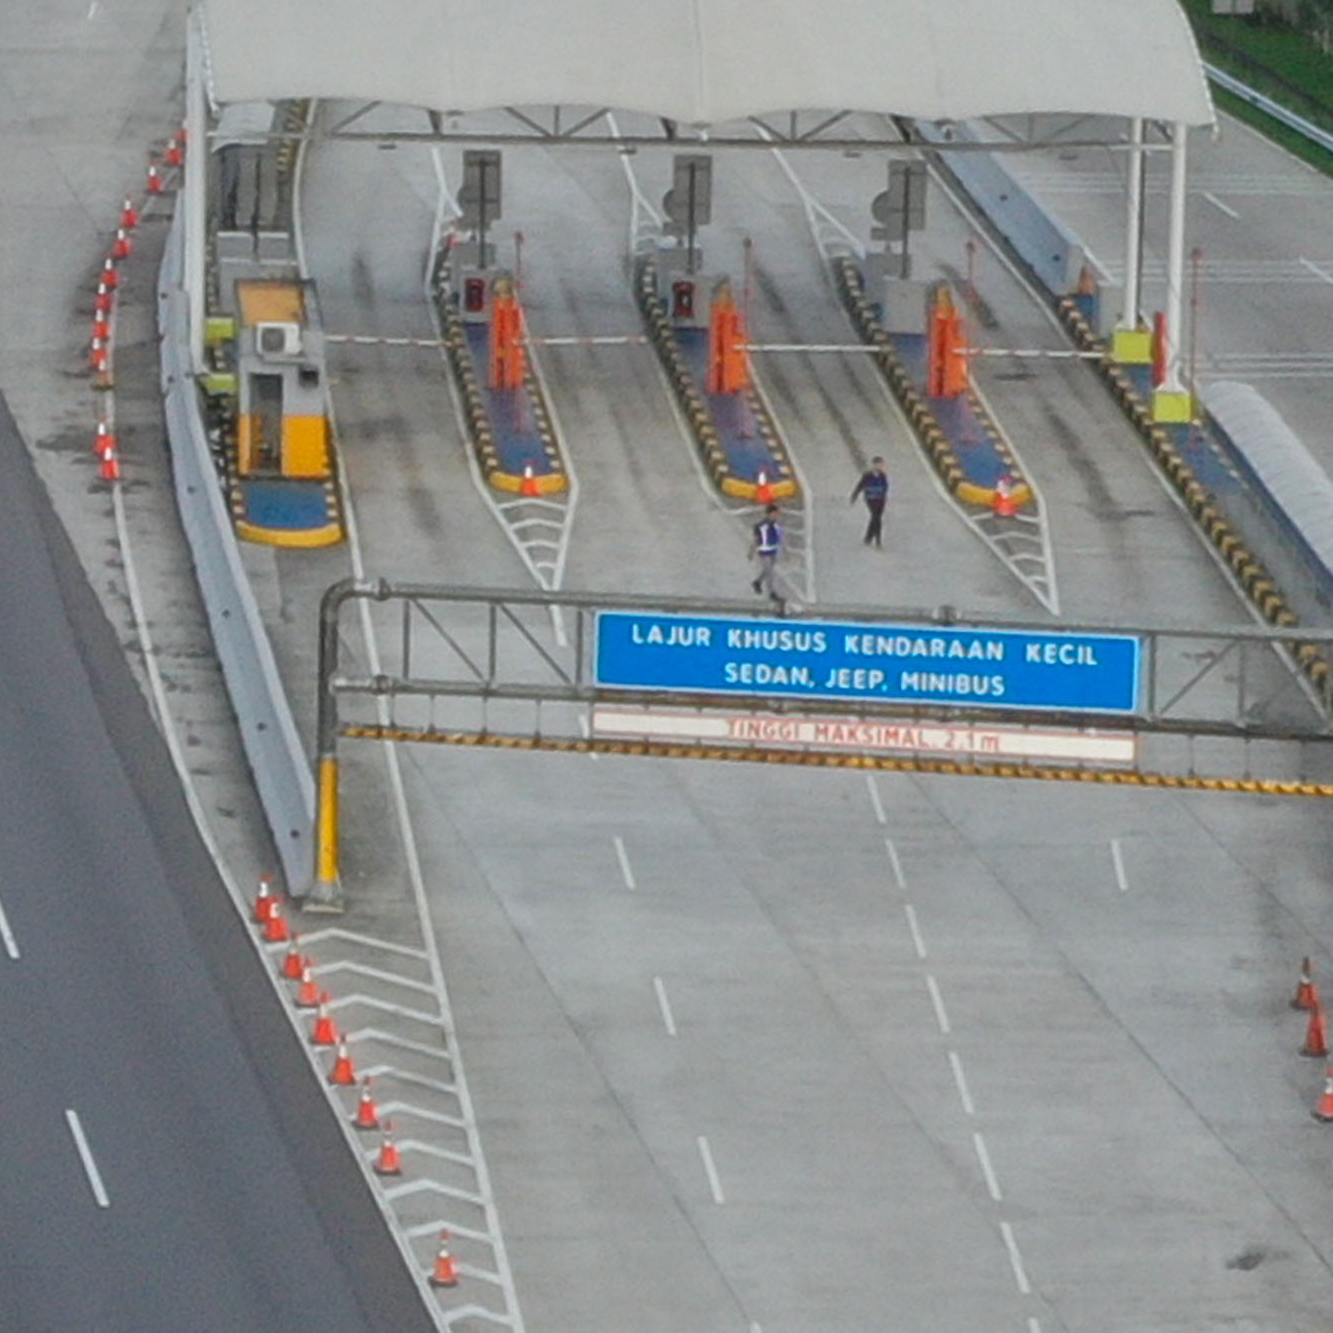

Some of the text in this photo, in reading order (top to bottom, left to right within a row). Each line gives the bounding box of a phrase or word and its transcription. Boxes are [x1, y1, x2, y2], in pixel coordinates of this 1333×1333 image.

[631, 623, 1098, 665] LAJUR KHUSUS KENDARAAN KECIL
[901, 671, 1006, 696] MINIBUS
[729, 719, 800, 743] TINGGI
